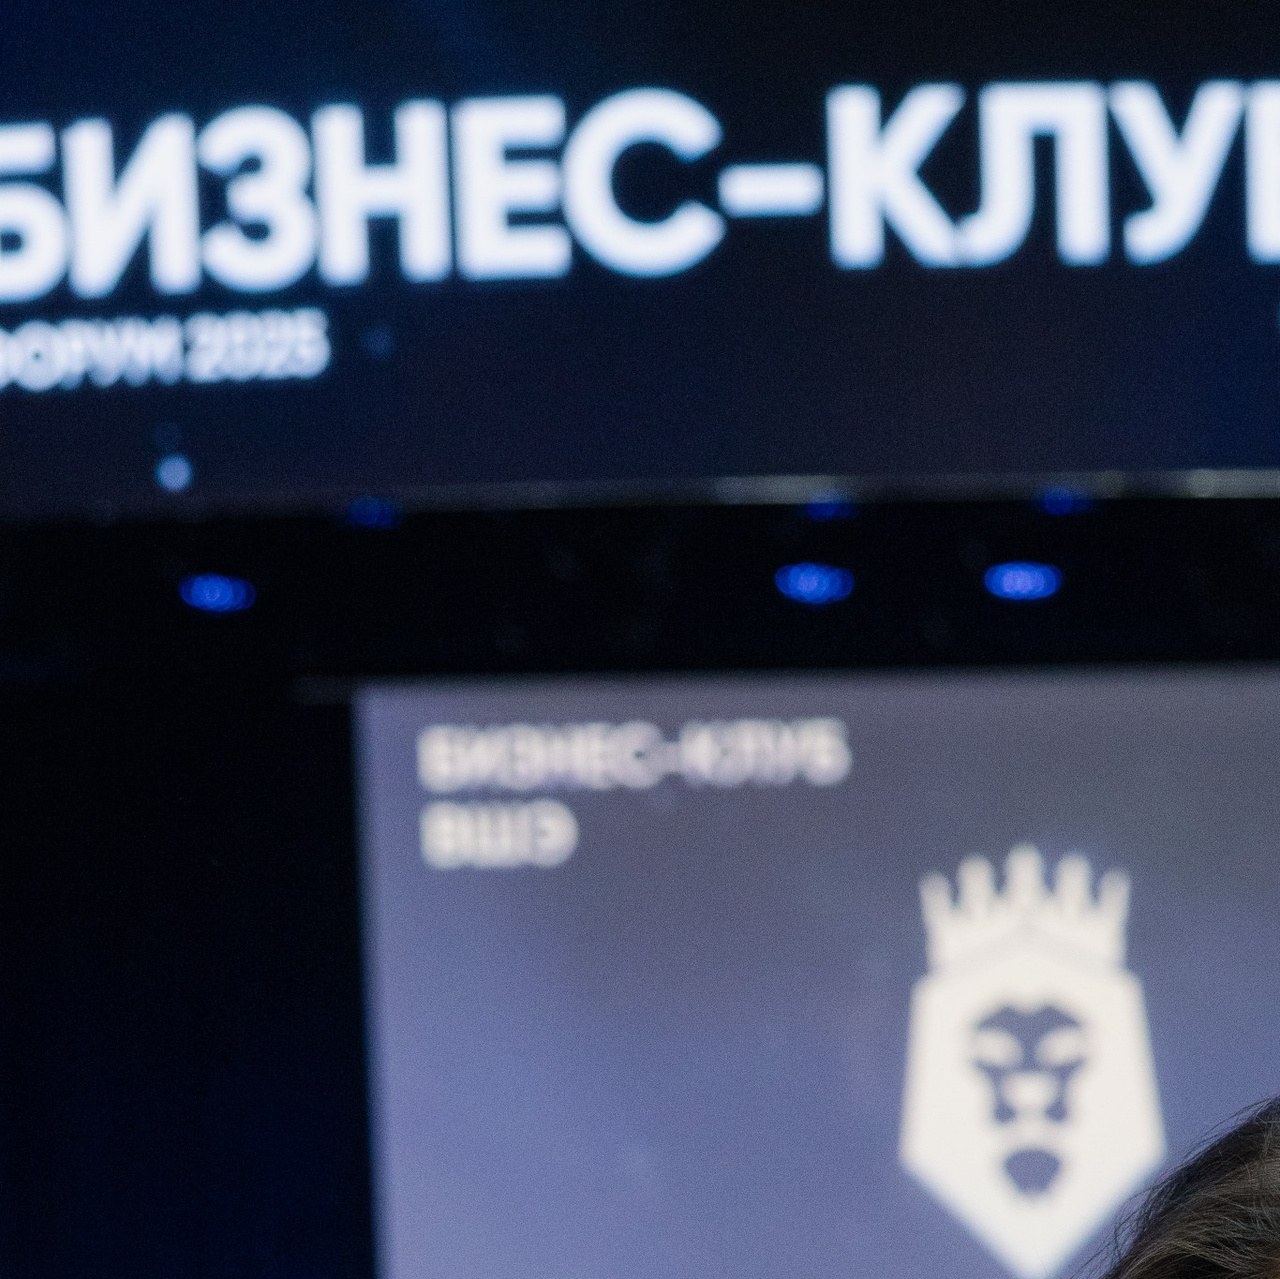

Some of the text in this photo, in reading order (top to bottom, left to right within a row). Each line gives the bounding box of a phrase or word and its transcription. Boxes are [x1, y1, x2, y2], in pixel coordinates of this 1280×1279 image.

[0, 308, 330, 390] ОРУМ 2025
[417, 718, 851, 792] БИЗНЕС-КЛУБ
[420, 798, 578, 869] ВШЭ
